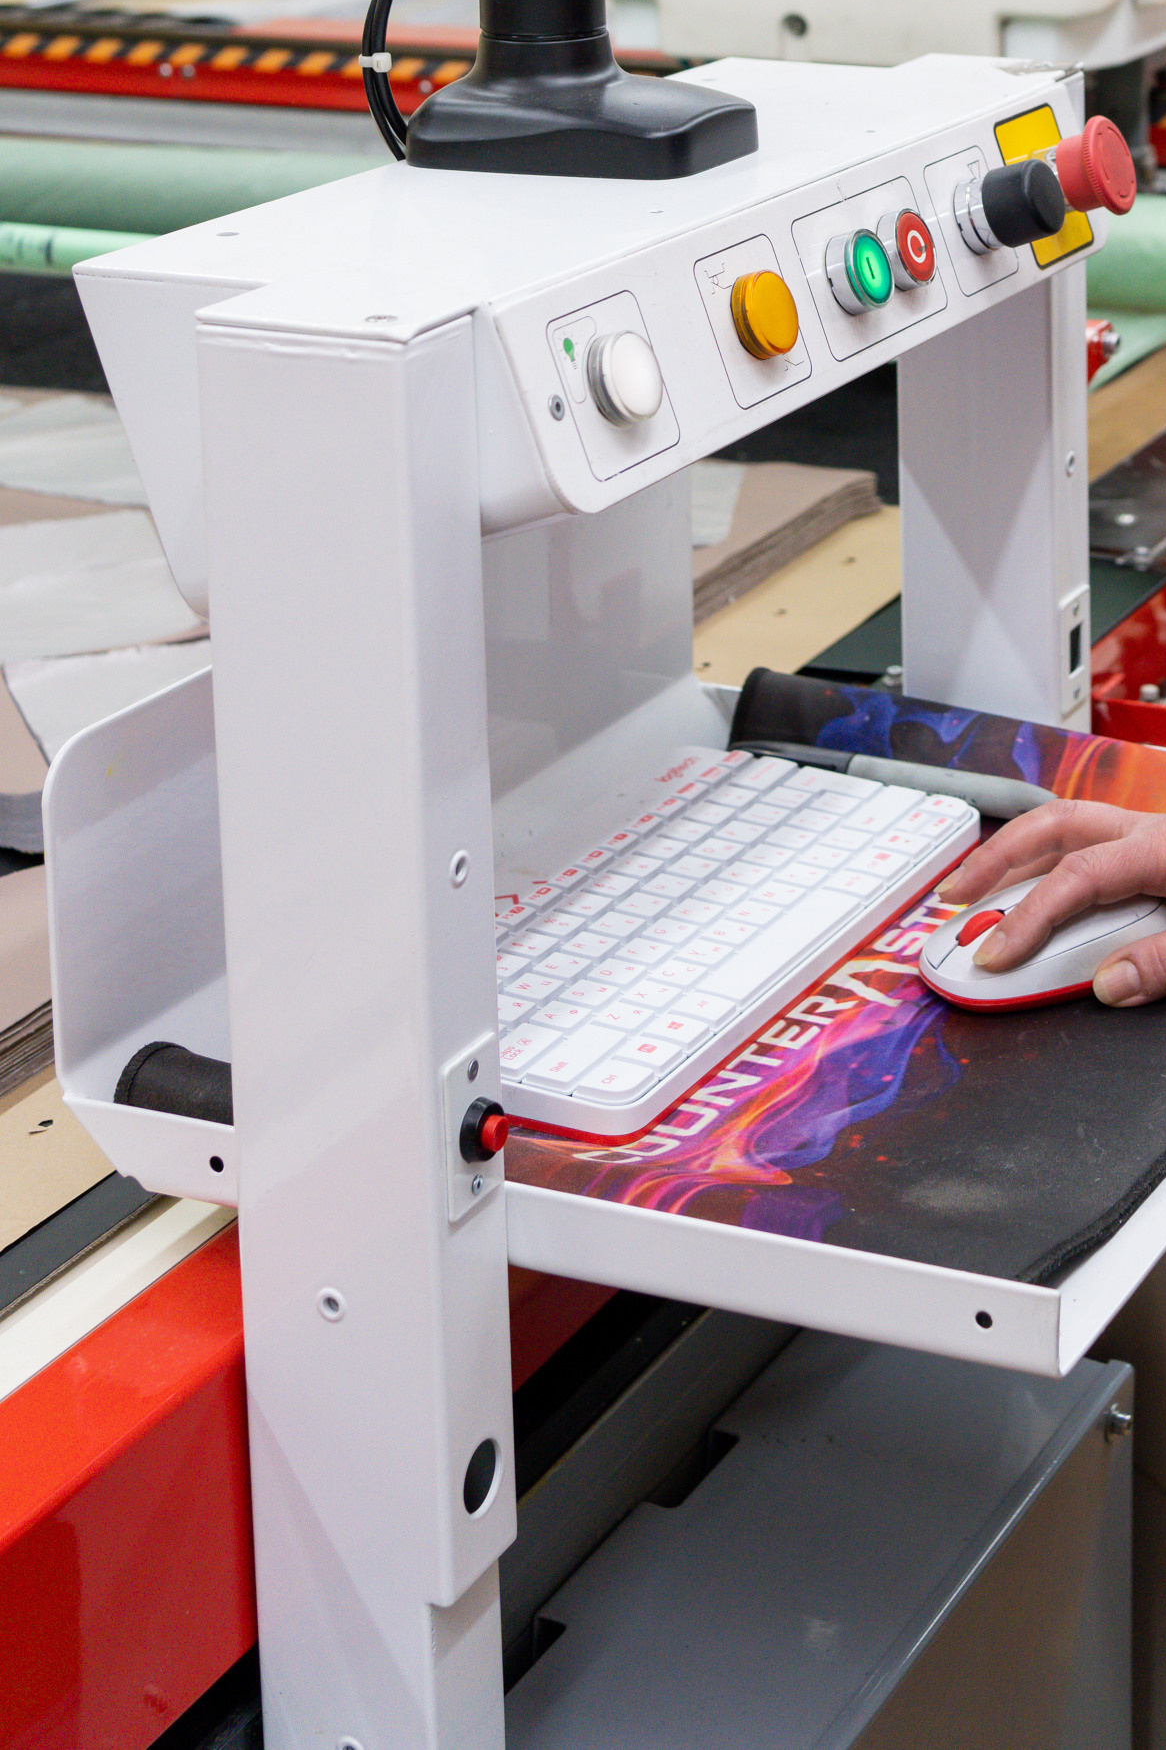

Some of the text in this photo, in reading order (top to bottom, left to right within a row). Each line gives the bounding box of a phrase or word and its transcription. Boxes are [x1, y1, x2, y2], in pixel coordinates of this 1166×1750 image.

[653, 927, 667, 935] G
[599, 969, 613, 977] D
[515, 982, 531, 991] W
[571, 989, 585, 997] S
[634, 991, 647, 999] X
[606, 1012, 620, 1021] Z
[549, 1060, 569, 1073] Shift
[601, 1074, 617, 1085] Ctrl
